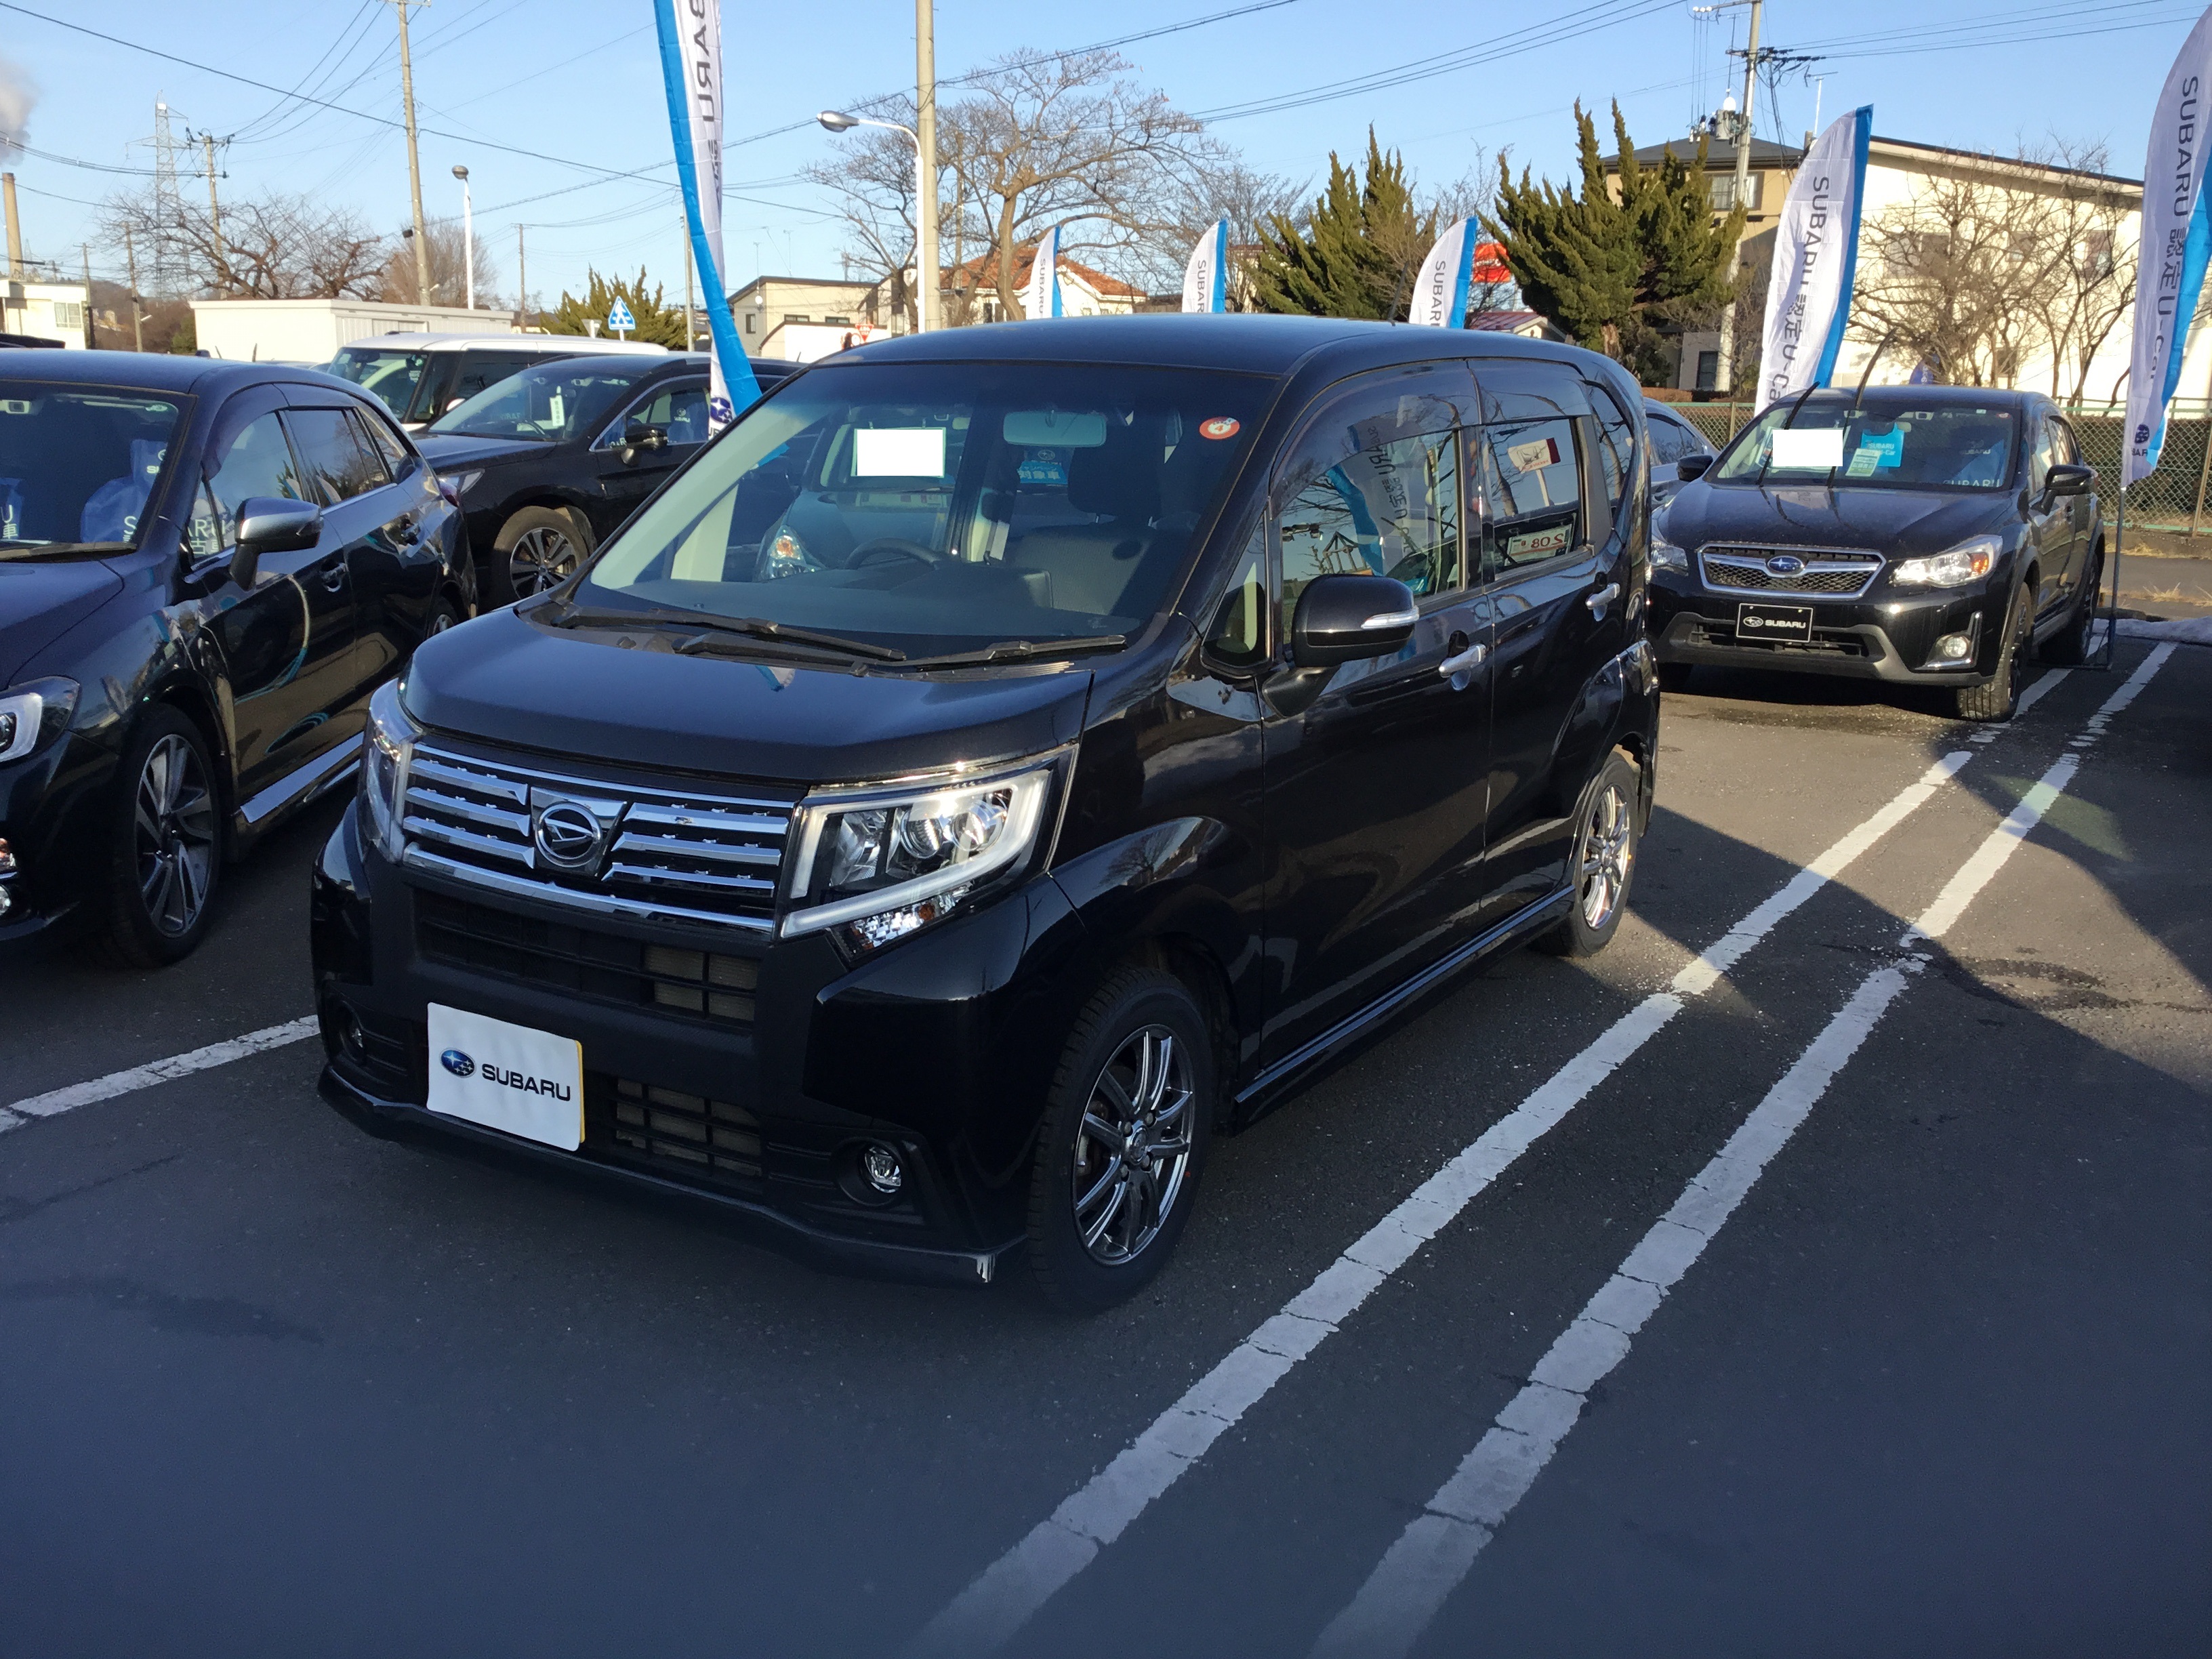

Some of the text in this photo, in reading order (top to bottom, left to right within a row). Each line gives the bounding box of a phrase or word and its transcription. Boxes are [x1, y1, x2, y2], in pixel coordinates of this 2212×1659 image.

[2173, 76, 2198, 217] SUBARU
[1429, 260, 1446, 327] SUBAR
[1869, 443, 1895, 451] SUBARU
[1765, 619, 1806, 629] SUBARU
[481, 1063, 571, 1102] SUBARU
